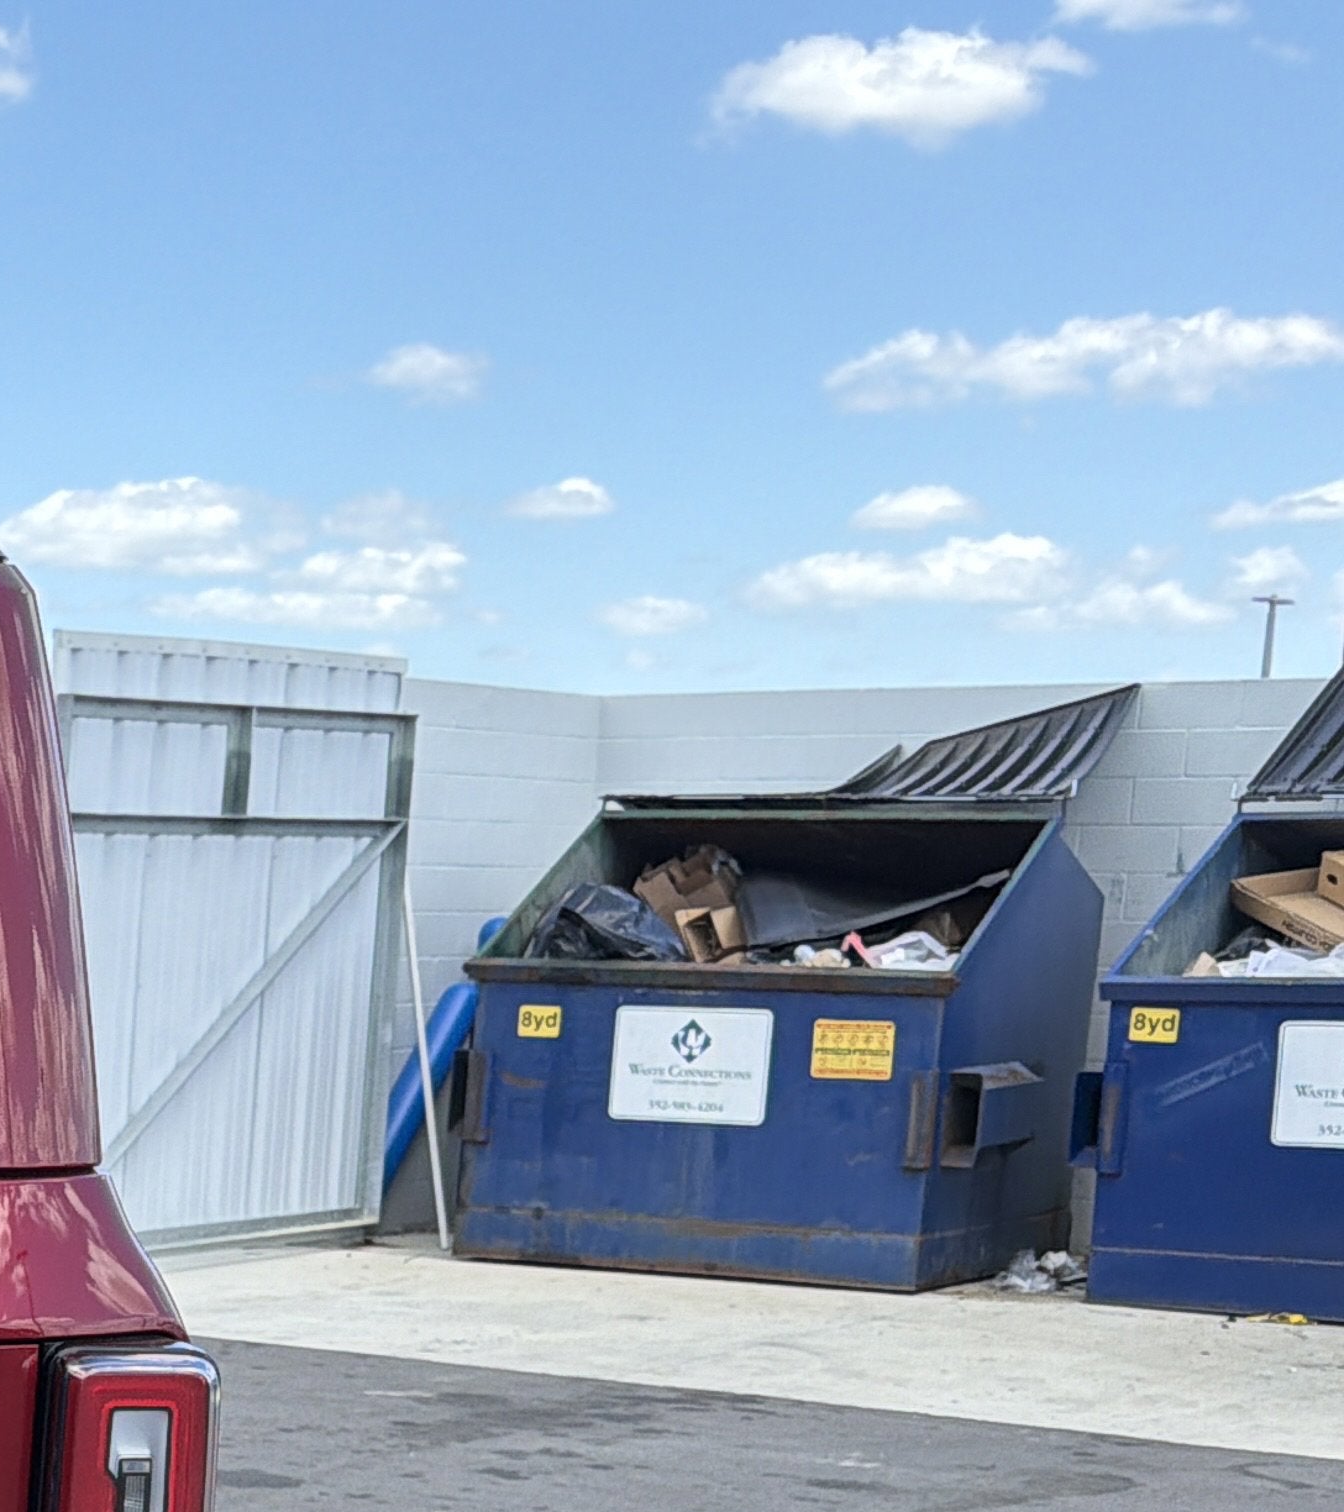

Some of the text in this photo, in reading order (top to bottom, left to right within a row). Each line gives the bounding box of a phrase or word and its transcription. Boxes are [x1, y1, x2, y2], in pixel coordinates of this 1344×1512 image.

[521, 1011, 558, 1033] 8yd
[1133, 1013, 1176, 1036] 8yd
[668, 1065, 752, 1081] CONNECTIONS
